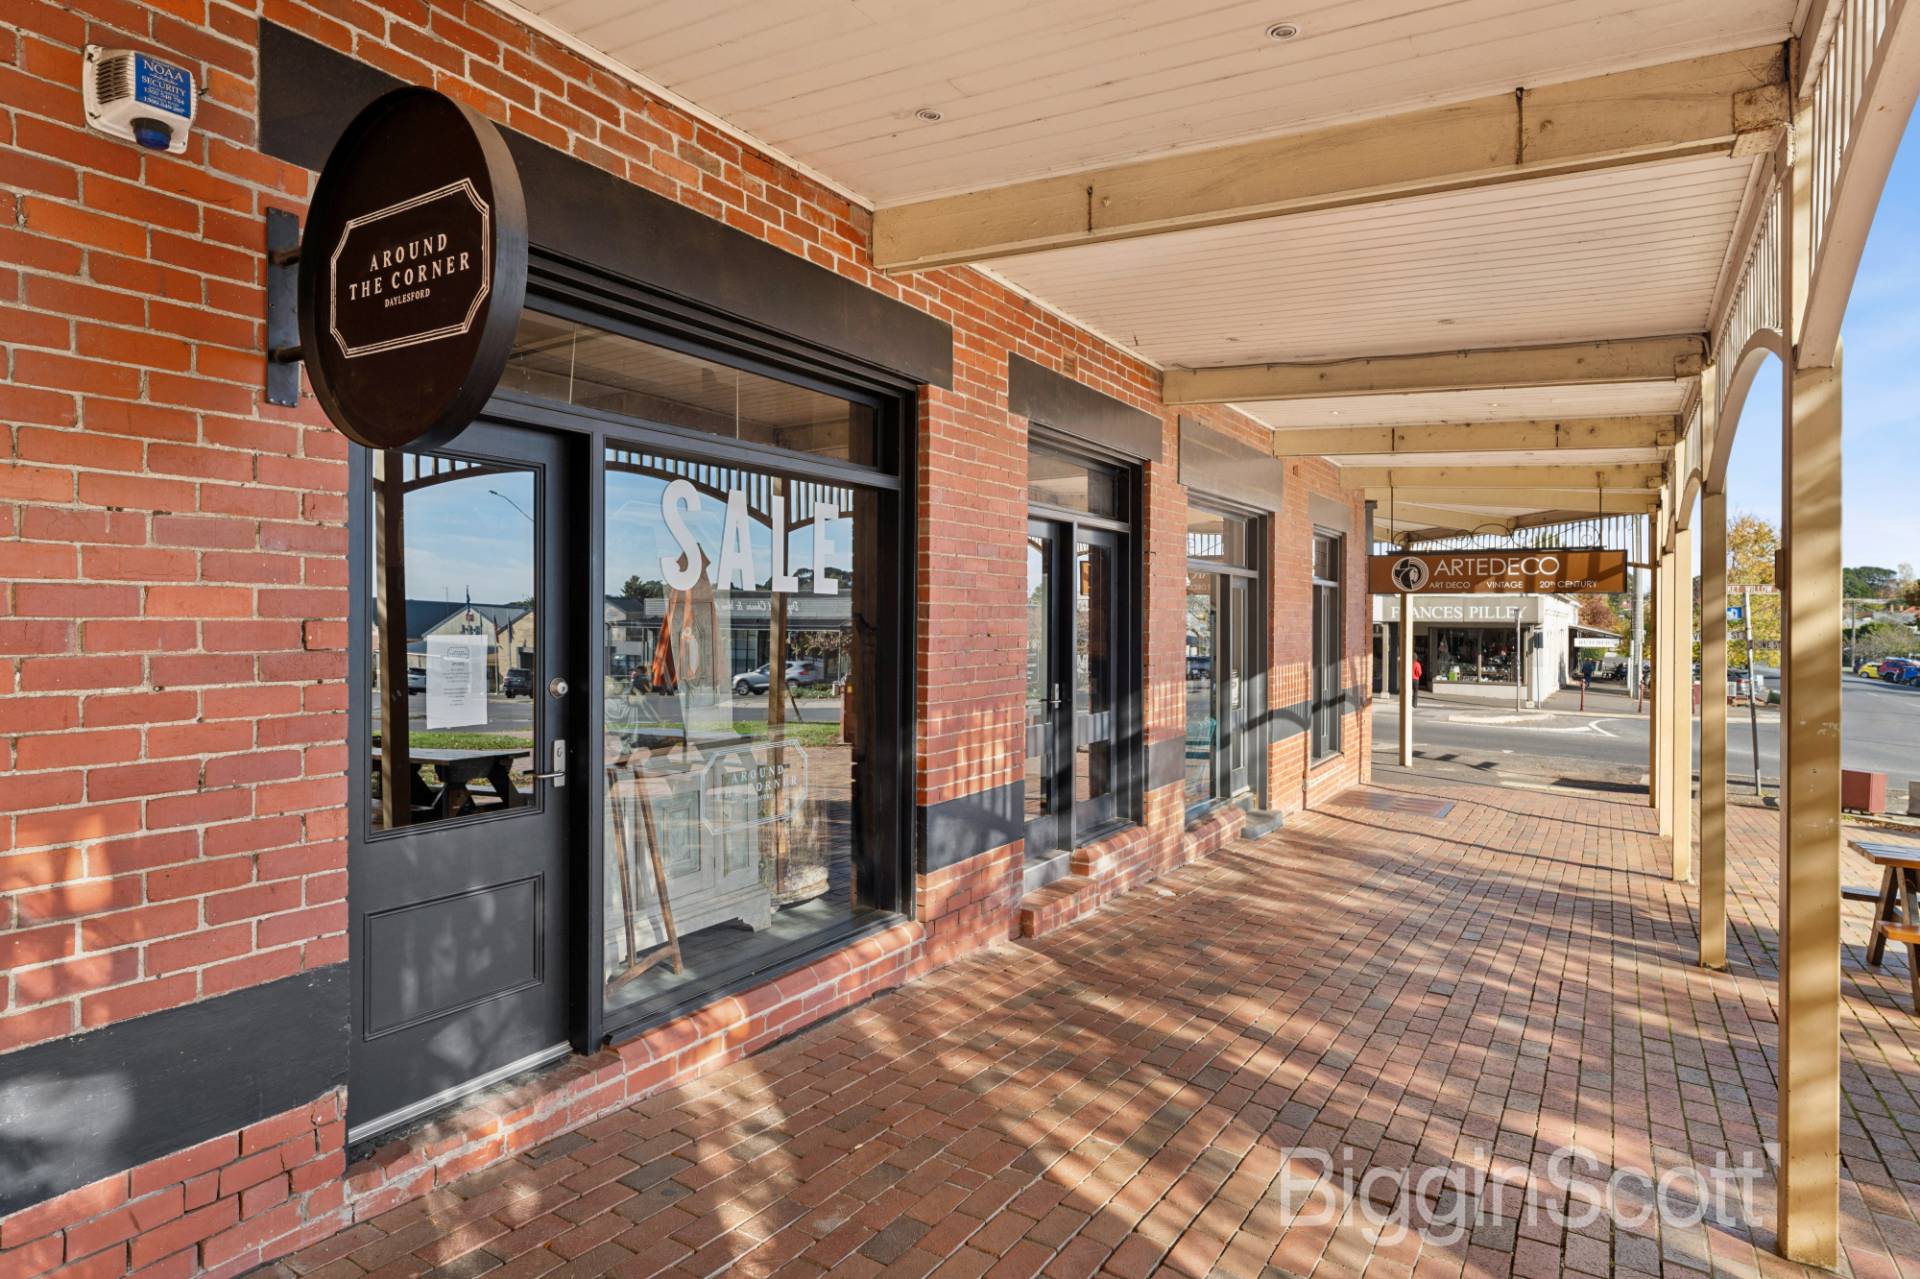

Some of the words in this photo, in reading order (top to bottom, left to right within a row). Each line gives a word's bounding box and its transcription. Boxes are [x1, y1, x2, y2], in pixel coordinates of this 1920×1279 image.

[144, 60, 184, 83] NOAA
[142, 75, 186, 97] SECURITY
[370, 234, 448, 272] AROUND
[349, 277, 383, 301] THE
[391, 252, 470, 289] CORNER
[384, 288, 431, 308] DAYLESFORD
[661, 479, 839, 595] SALE
[1434, 556, 1560, 577] ARTEDECO
[1486, 581, 1524, 589] VINTAGE
[1557, 581, 1598, 589] CENTURY
[1391, 606, 1464, 619] FANCES
[1469, 606, 1528, 619] PILLEY
